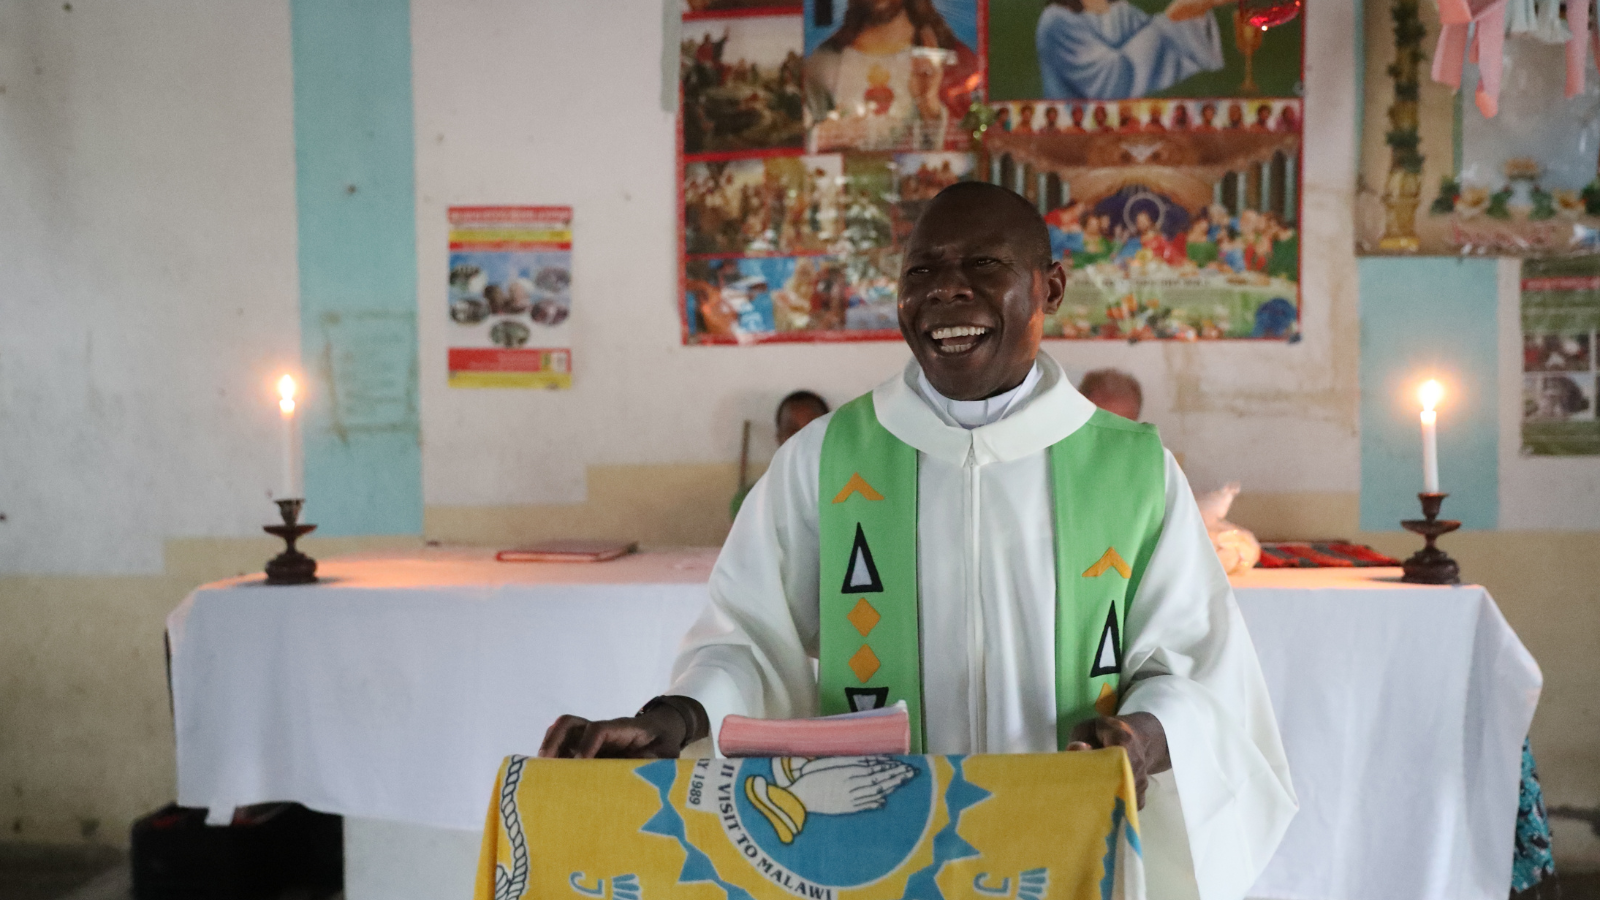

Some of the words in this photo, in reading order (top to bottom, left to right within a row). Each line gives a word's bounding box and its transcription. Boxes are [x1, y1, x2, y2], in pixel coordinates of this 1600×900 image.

[720, 764, 735, 778] II
[689, 774, 705, 805] 1989
[718, 783, 741, 832] VISIT
[736, 833, 758, 858] TO
[757, 858, 832, 900] MALAWI
